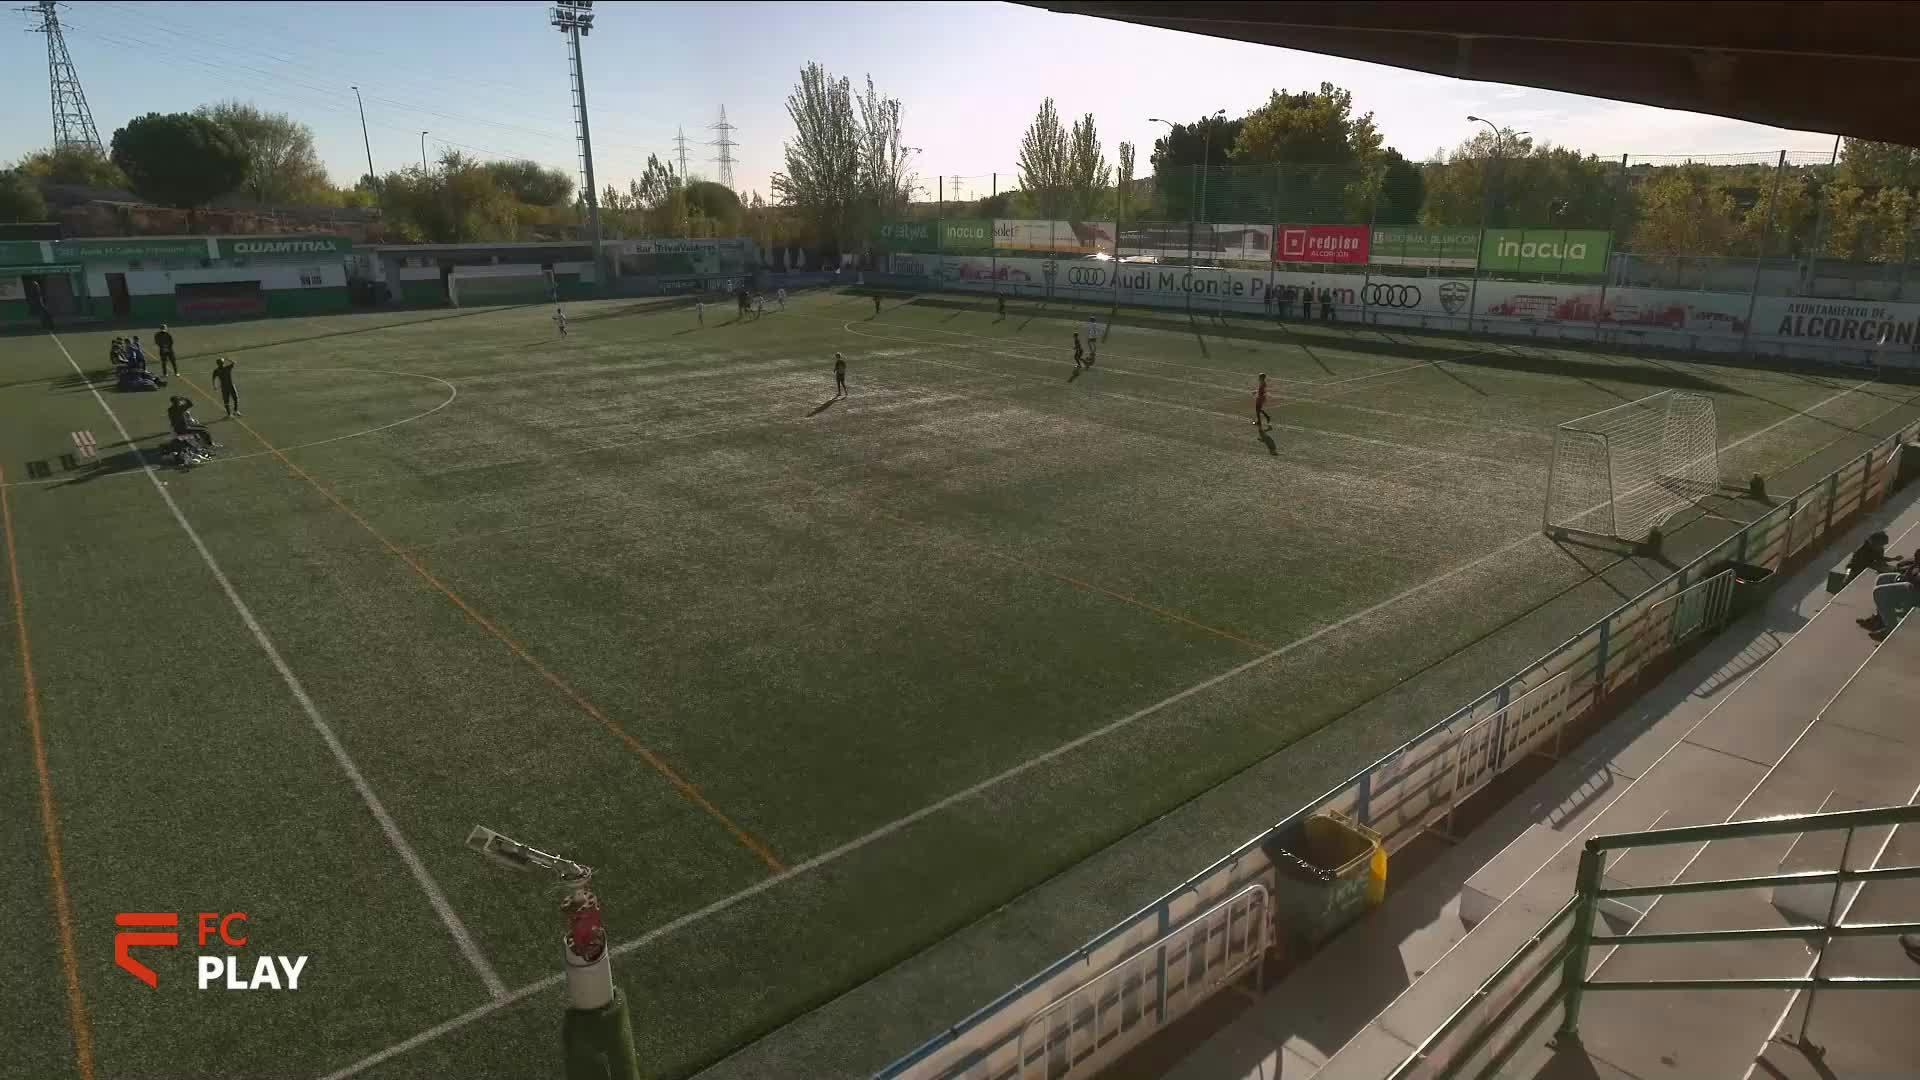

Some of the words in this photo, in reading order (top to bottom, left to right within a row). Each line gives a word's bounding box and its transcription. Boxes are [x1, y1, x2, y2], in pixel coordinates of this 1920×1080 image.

[234, 240, 337, 254] QUAMTRAX
[1309, 235, 1360, 251] redpiso
[1497, 236, 1586, 260] inacua
[1109, 271, 1151, 291] Audi
[1158, 271, 1244, 297] M.Conde
[1787, 303, 1868, 318] AYUNTAMIENTO
[1871, 308, 1887, 319] DE
[1778, 314, 1913, 345] ALCORCÓN
